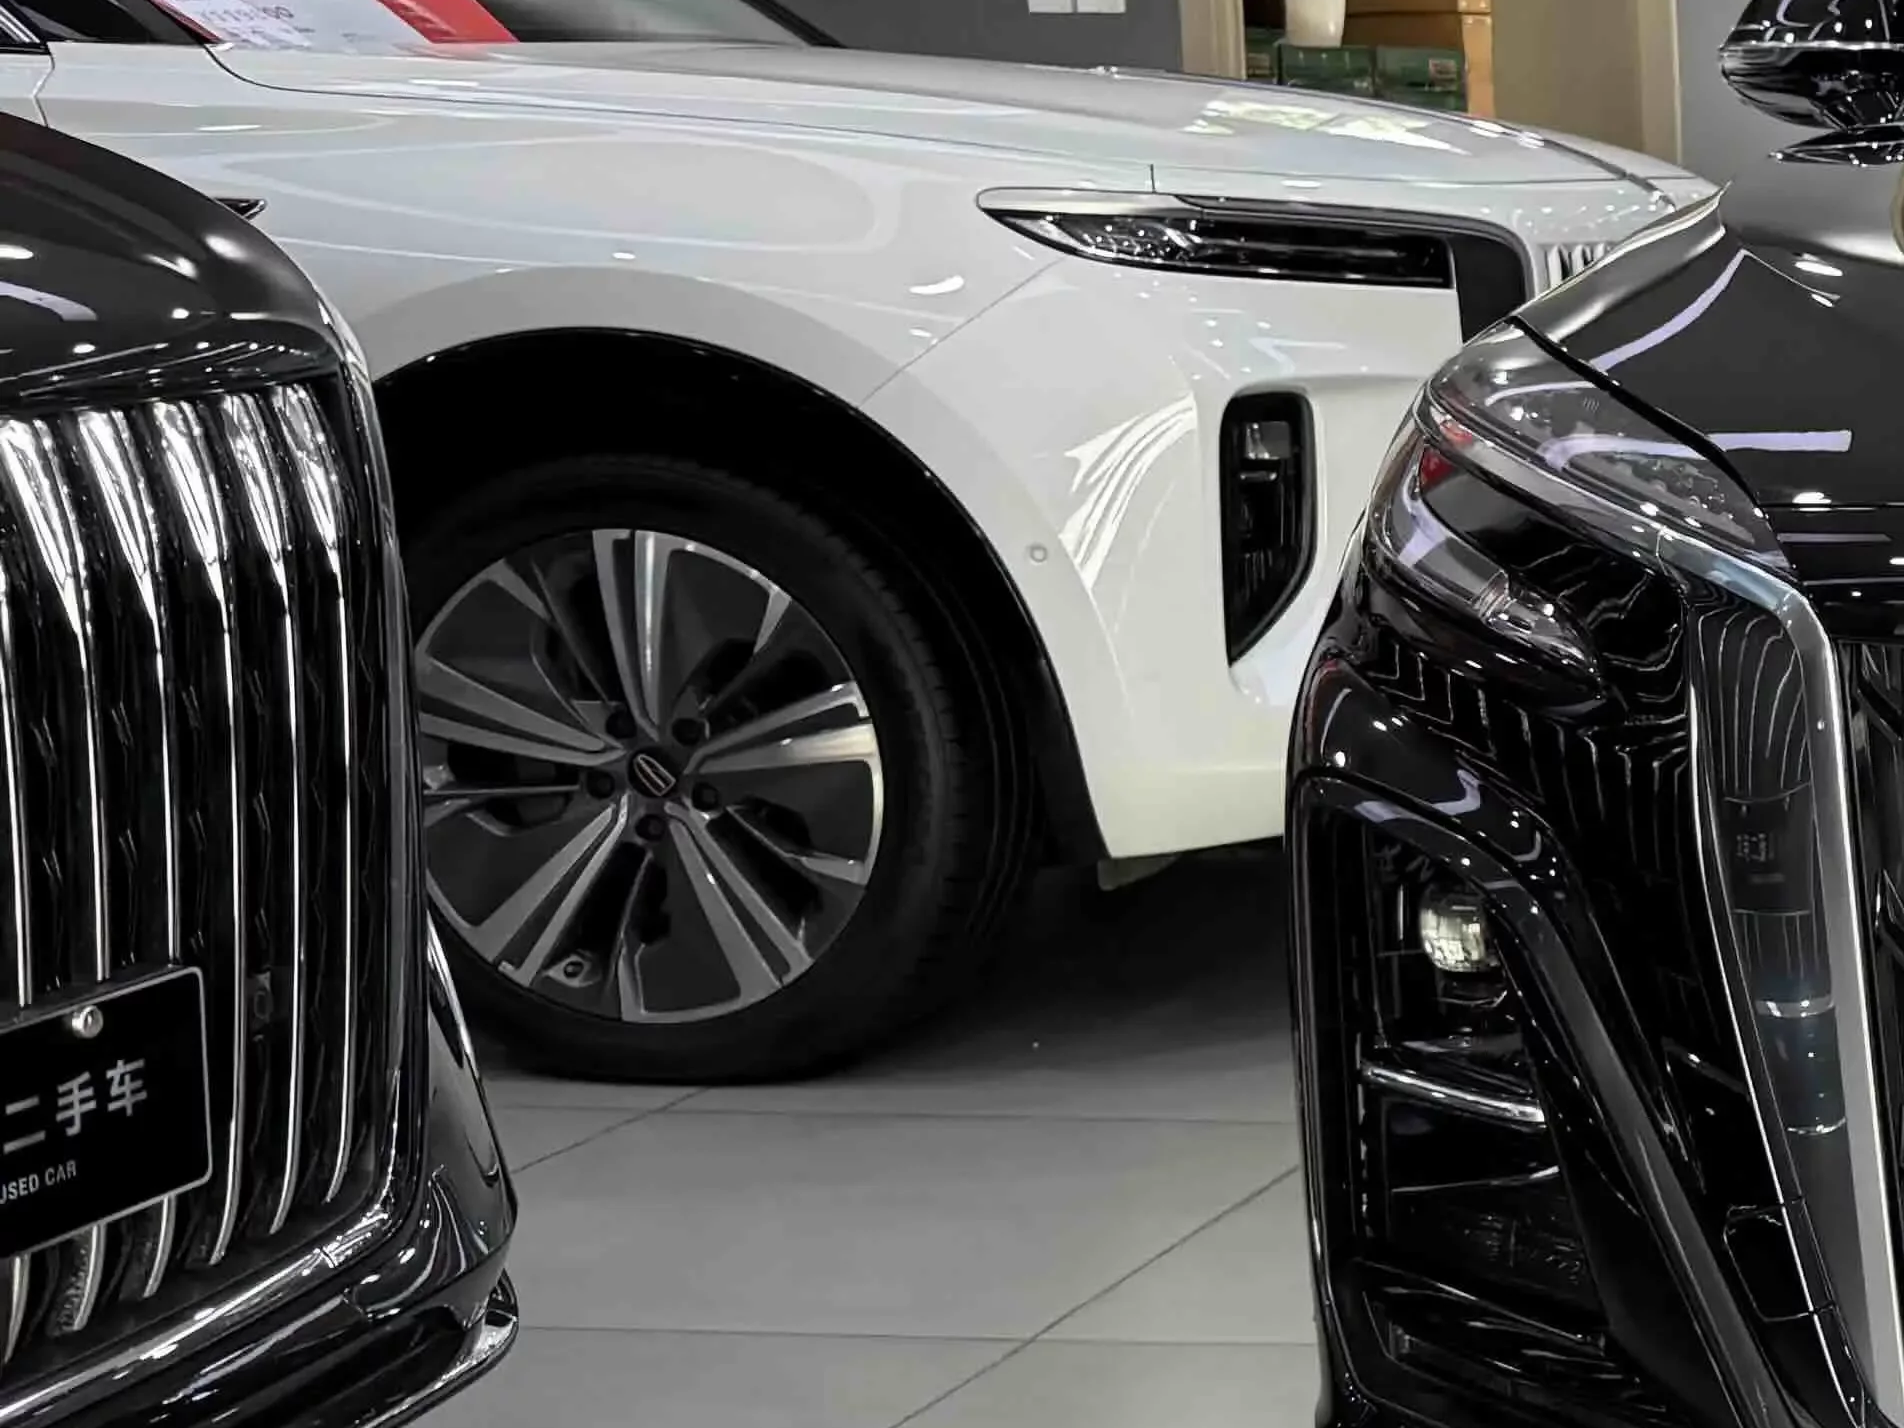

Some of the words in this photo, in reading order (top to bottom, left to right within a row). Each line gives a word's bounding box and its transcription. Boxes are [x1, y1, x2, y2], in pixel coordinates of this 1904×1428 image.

[2, 1058, 148, 1155] 二手车
[44, 1159, 77, 1187] CAR
